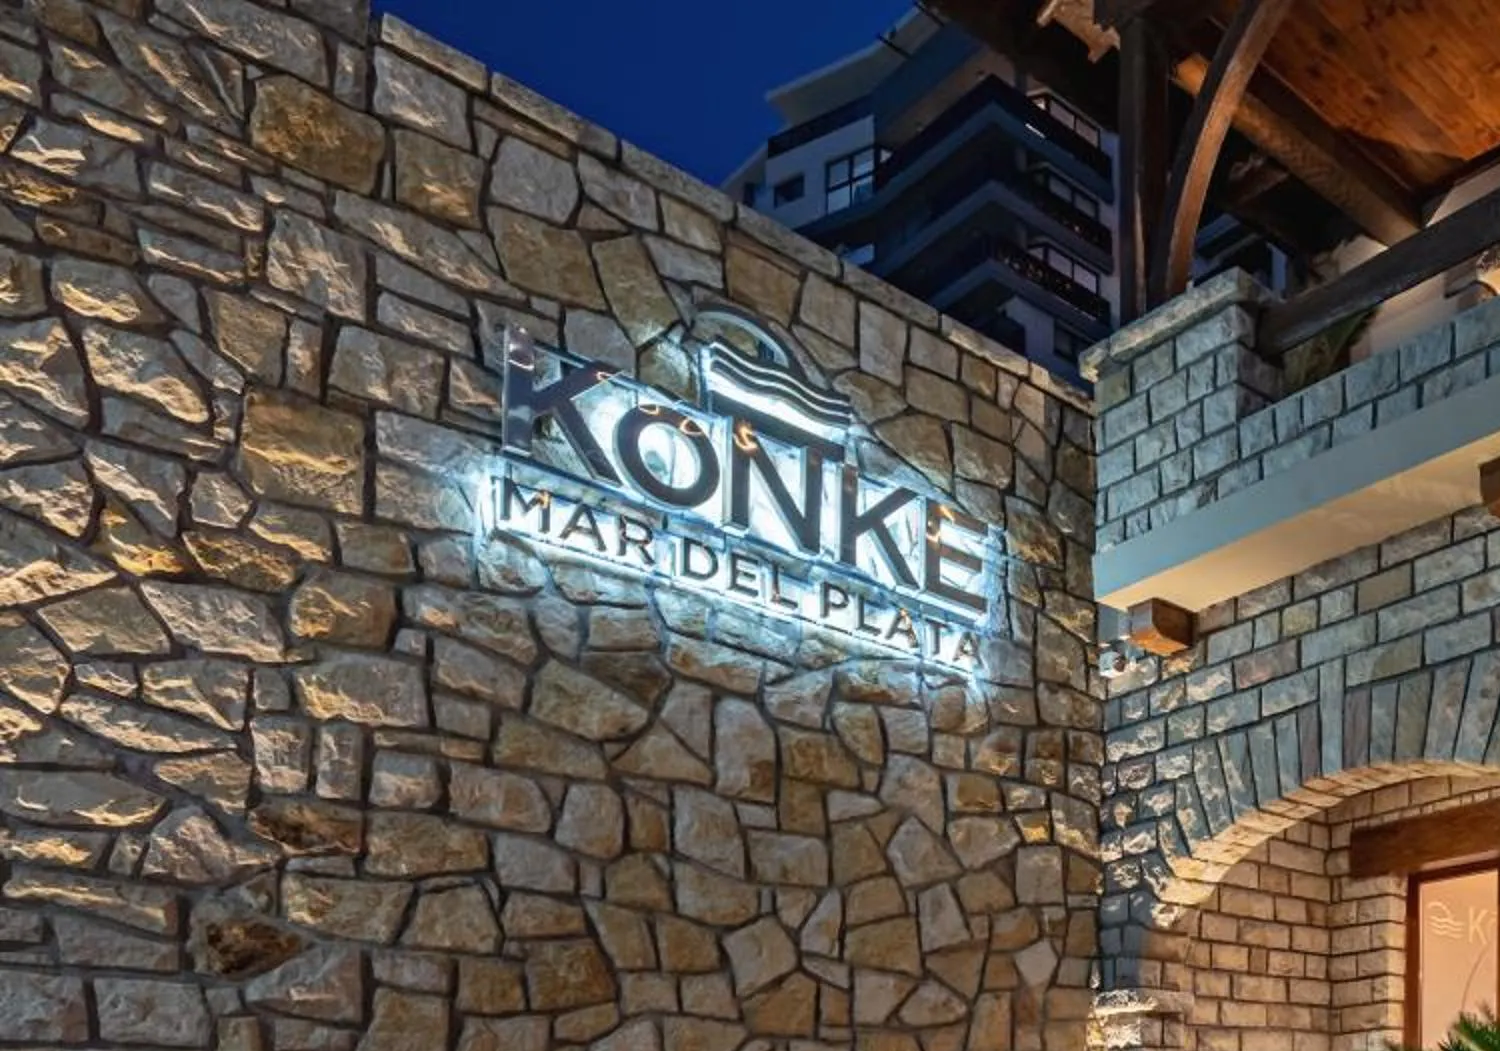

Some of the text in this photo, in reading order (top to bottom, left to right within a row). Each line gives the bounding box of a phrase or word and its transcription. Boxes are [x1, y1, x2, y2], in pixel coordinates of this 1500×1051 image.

[500, 476, 984, 666] MAR DEL PLATA
[502, 325, 990, 617] KONKE
